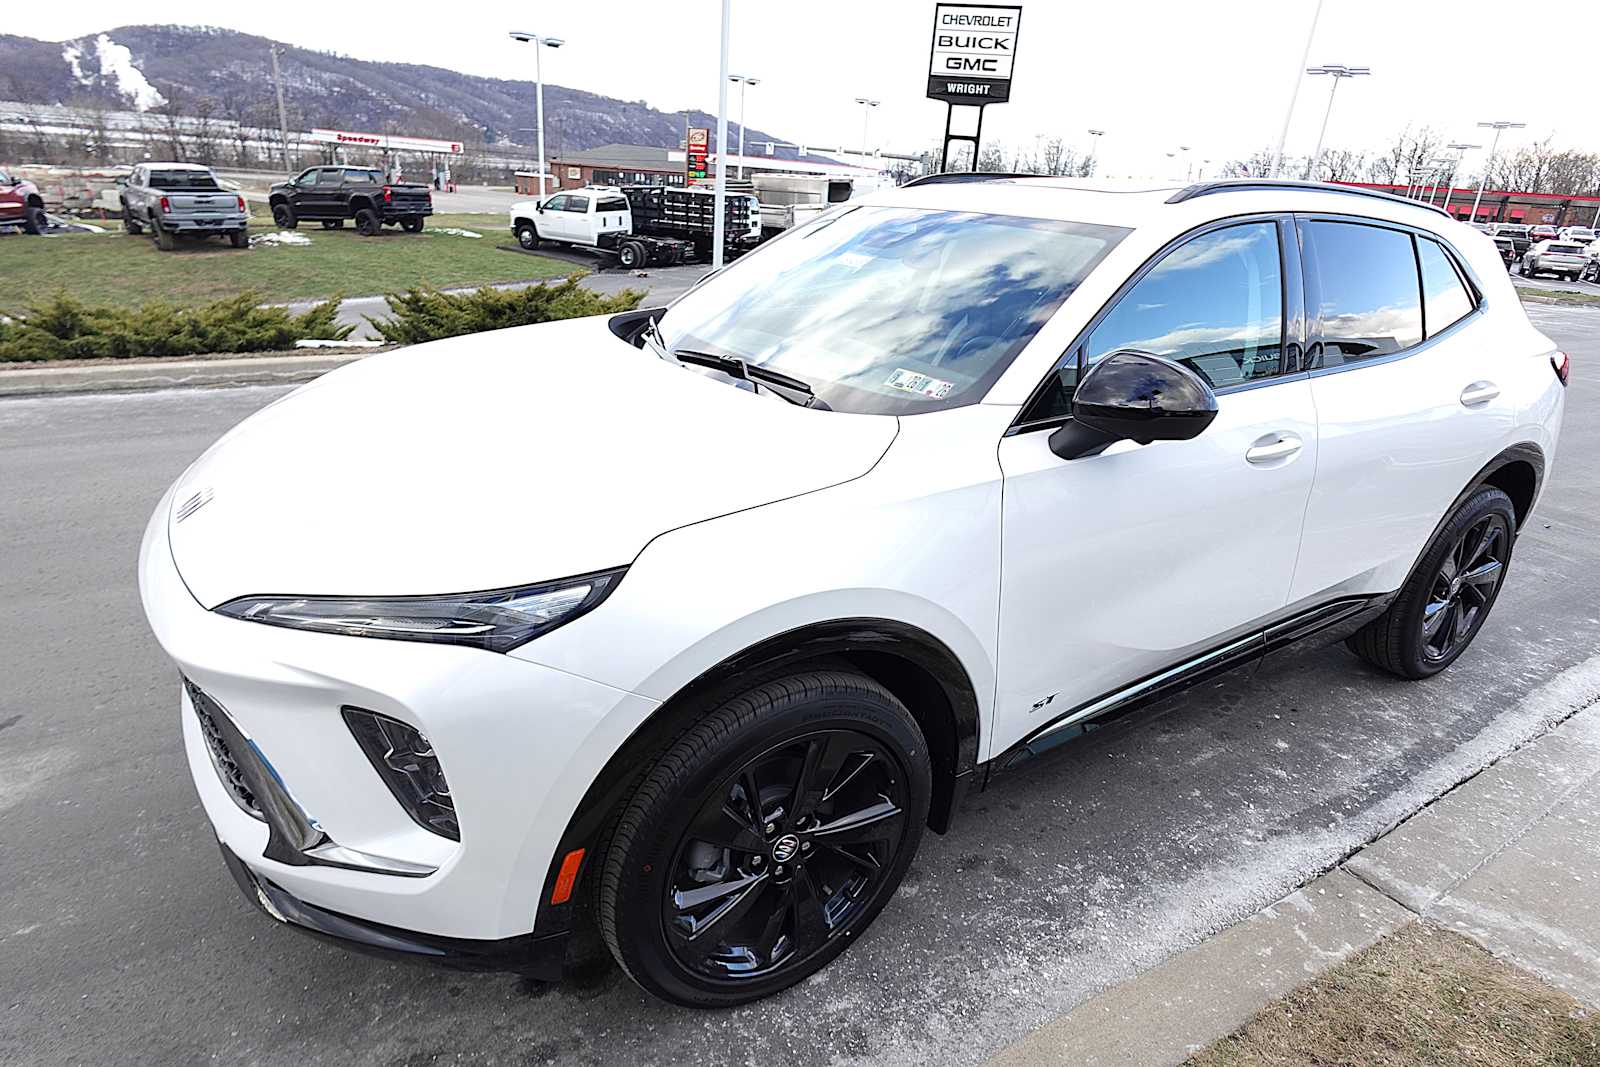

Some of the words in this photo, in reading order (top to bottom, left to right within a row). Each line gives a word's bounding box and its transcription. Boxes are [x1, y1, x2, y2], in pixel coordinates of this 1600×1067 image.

[942, 14, 1013, 27] CHEVROLET
[938, 35, 1010, 50] BUICK
[946, 57, 998, 72] GMC
[947, 82, 991, 95] WRIGHT
[336, 133, 381, 145] Speedway
[1029, 692, 1061, 713] ST
